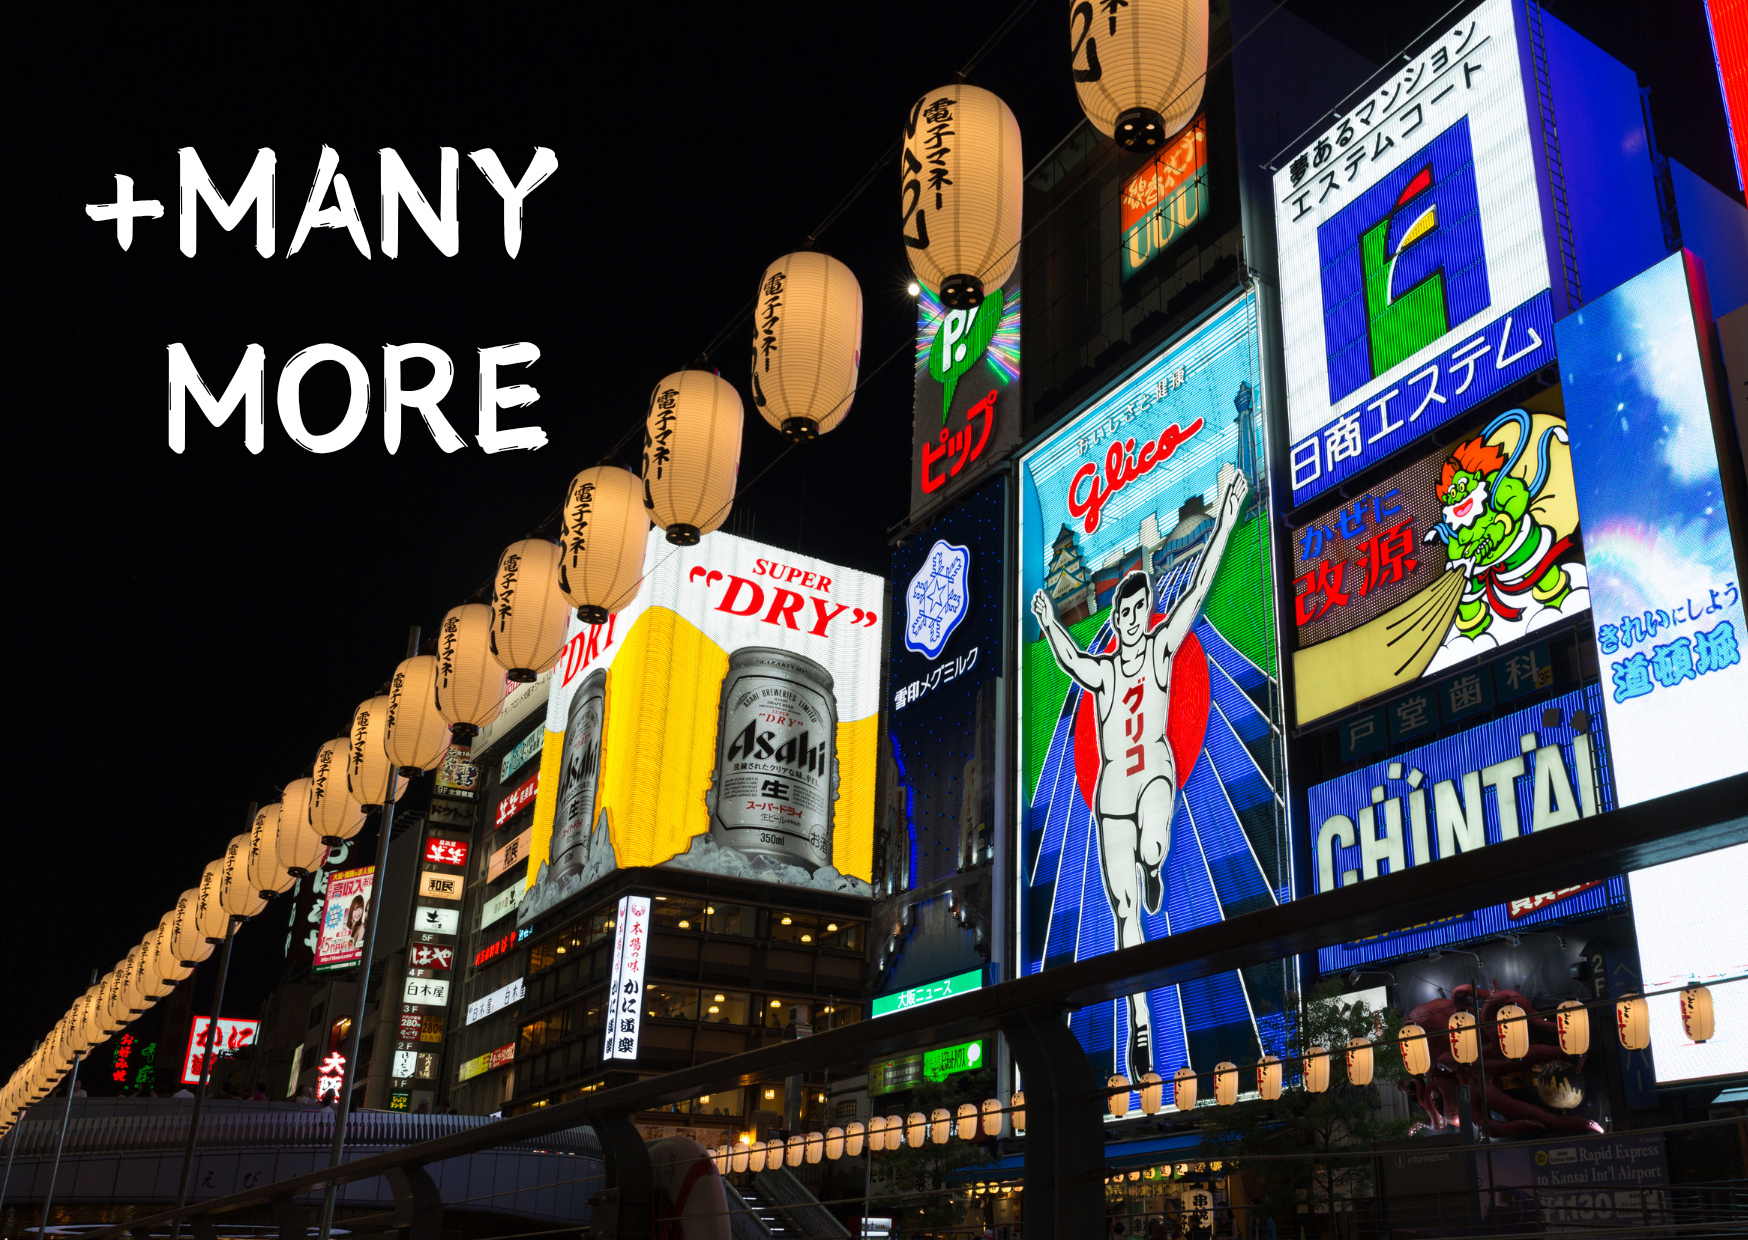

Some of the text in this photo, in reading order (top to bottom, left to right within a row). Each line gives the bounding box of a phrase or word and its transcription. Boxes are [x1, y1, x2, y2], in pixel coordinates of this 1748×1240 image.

[1289, 22, 1476, 188] 夢あるマンション
[923, 97, 958, 211] 電子マネー
[1292, 62, 1482, 222] エステムコート
[761, 272, 787, 373] 電子マネー
[652, 388, 679, 481] 電子マネー
[1076, 364, 1187, 457] おいしさと健康
[1289, 316, 1543, 491] 日商エステム
[921, 388, 998, 494] ピップ
[1067, 416, 1204, 534] Glico
[570, 482, 596, 569] 電子マネー
[1300, 488, 1401, 562] かぜに
[498, 553, 522, 633] 電子マネー
[752, 557, 833, 595] SUPER
[1291, 514, 1421, 627] 改源
[1597, 582, 1740, 655] きれいにしよう
[441, 616, 460, 689] 電子マネー
[894, 646, 980, 712] 雪印メグミルク
[1612, 620, 1742, 704] 道頓堀
[387, 672, 405, 740] 電子マネー
[743, 692, 760, 709] ASAHI
[761, 688, 798, 703] BREWERIES
[798, 699, 818, 724] LIMITED
[1122, 676, 1147, 778] グリコ
[1348, 654, 1541, 752] 戸堂歯科
[352, 711, 371, 776] 電子マネー
[727, 718, 826, 778] Asahi
[315, 749, 334, 808] 電子マネー
[746, 800, 804, 819] スーパードライ
[760, 779, 790, 802] 生
[760, 832, 785, 846] 350ml
[331, 878, 364, 899] 高収入
[430, 879, 454, 892] 和民
[412, 945, 453, 968] はや
[421, 934, 434, 942] 5F
[626, 920, 643, 973] 本場の味
[407, 982, 445, 998] 白木屋
[408, 968, 424, 977] 4F
[897, 979, 952, 1009] 大阪ニュース
[403, 1005, 418, 1013] 3F
[617, 978, 639, 1054] かに道楽
[397, 1042, 413, 1050] 2F
[393, 1080, 408, 1088] 1F
[1407, 1152, 1450, 1164] information
[1537, 1165, 1663, 1185] to Kansai Int'l Airport
[1578, 1144, 1660, 1166] Rapid Express
